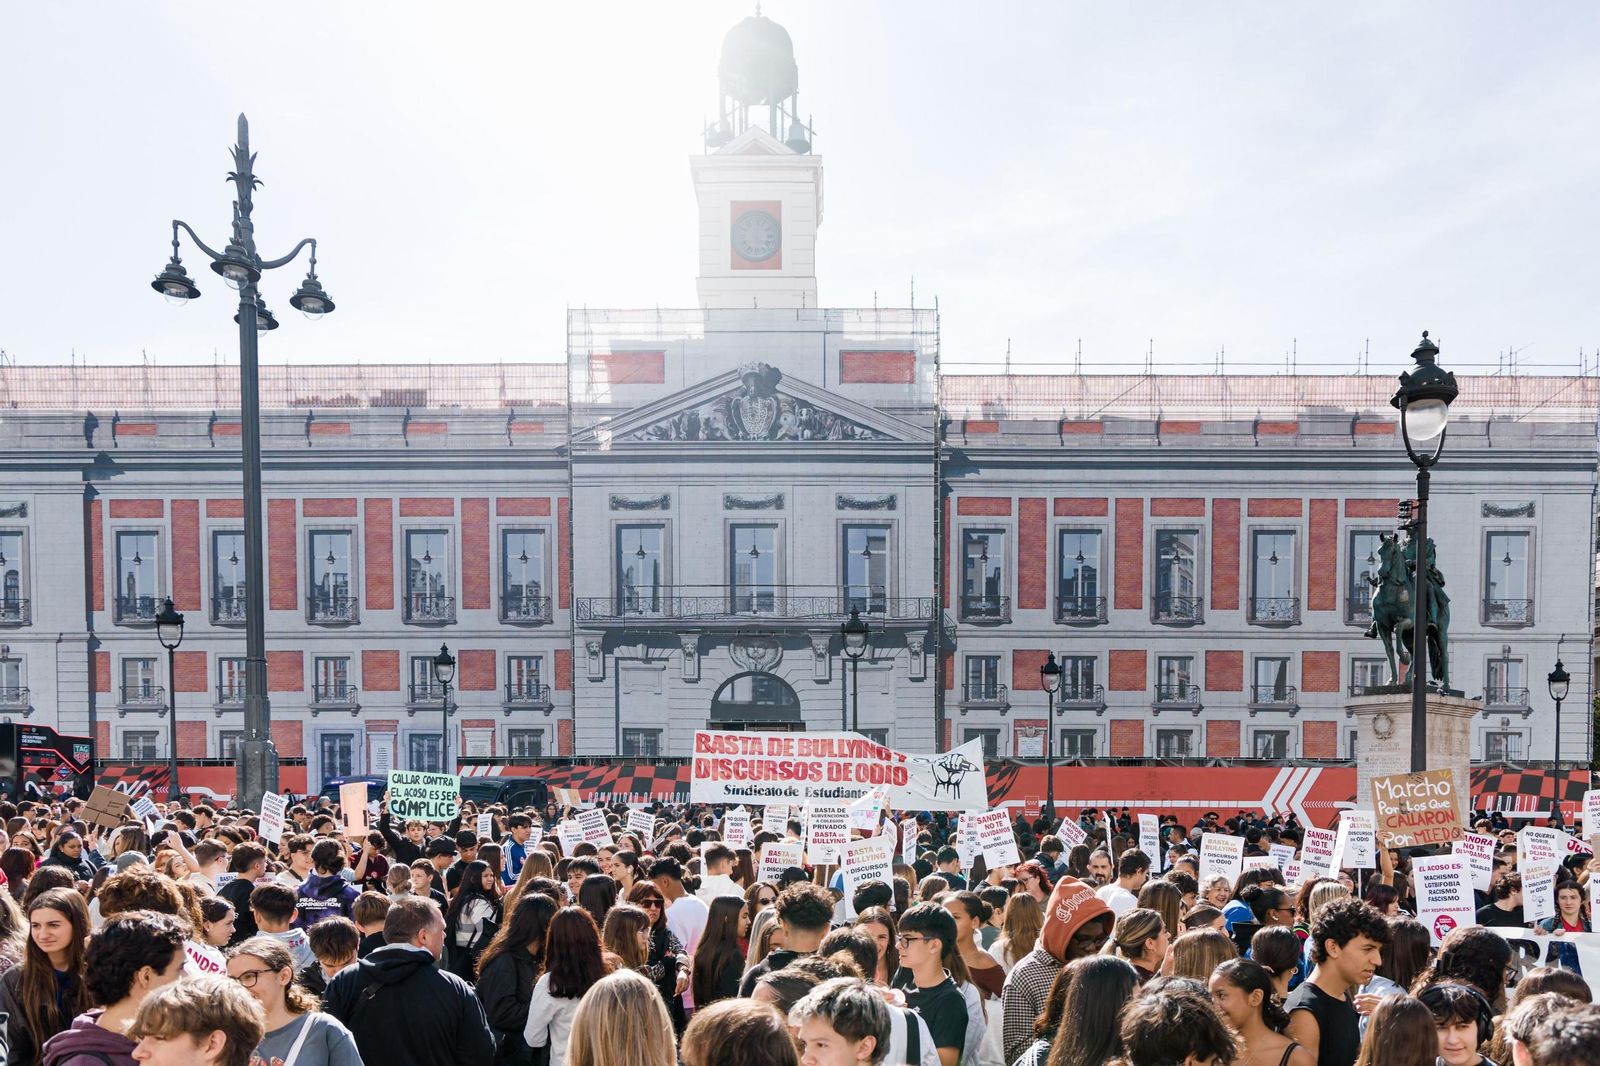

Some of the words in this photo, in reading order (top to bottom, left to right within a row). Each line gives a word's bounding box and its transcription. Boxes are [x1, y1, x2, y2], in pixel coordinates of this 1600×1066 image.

[75, 745, 89, 753] TAG
[696, 733, 763, 755] BASTA
[767, 737, 794, 756] DE
[797, 738, 892, 762] BULLYING
[694, 758, 823, 782] DISCURSOS
[827, 761, 853, 782] DE
[855, 762, 908, 786] ODIO
[392, 773, 420, 785] CALLAR
[422, 775, 453, 787] CONTRA
[391, 787, 402, 797] EL
[403, 787, 427, 799] ACOSO
[429, 790, 440, 800] ES
[441, 790, 458, 801] SER
[724, 784, 783, 796] Sindicato
[784, 786, 799, 797] de
[1375, 777, 1451, 800] Marcho
[588, 791, 639, 803] COMUNIDAD
[643, 791, 653, 803] DE
[657, 791, 691, 803] MADRID
[390, 797, 456, 817] CÓMPLICE
[1378, 800, 1399, 816] Por
[1406, 800, 1427, 811] Los
[1428, 799, 1451, 809] Que
[1486, 795, 1539, 812] MADRID
[579, 812, 592, 820] BASTA
[976, 811, 1007, 825] SANDRA
[1386, 809, 1455, 828] CALLARON
[582, 822, 604, 831] PRIVADOS
[1064, 819, 1085, 839] SANDRA
[1066, 827, 1074, 835] NO
[585, 832, 608, 841] BULLYING
[980, 826, 1011, 839] OLVIDAMOS
[1307, 830, 1333, 841] SANDRA
[1384, 831, 1413, 848] Por
[1413, 827, 1460, 844] MIEDO
[982, 839, 1014, 850] RESPONSABLES
[1208, 838, 1229, 846] BASTA
[1311, 839, 1320, 847] NO
[848, 846, 874, 857] BASTA
[1205, 844, 1238, 853] BULLYING
[1305, 846, 1332, 857] OLVIDAMOS
[765, 857, 798, 865] BULLYING
[846, 852, 886, 866] BULLYING
[1207, 852, 1238, 860] DISCURSOS
[850, 862, 888, 874] DISCURSOS
[1303, 860, 1330, 869] RESPONSABLES
[1526, 866, 1544, 874] BASTA
[861, 871, 881, 880] ODIO
[1525, 870, 1551, 880] BULLYING
[1528, 879, 1551, 888] DISCURSOS
[1535, 885, 1548, 893] ODIO
[1506, 938, 1584, 988] RA
